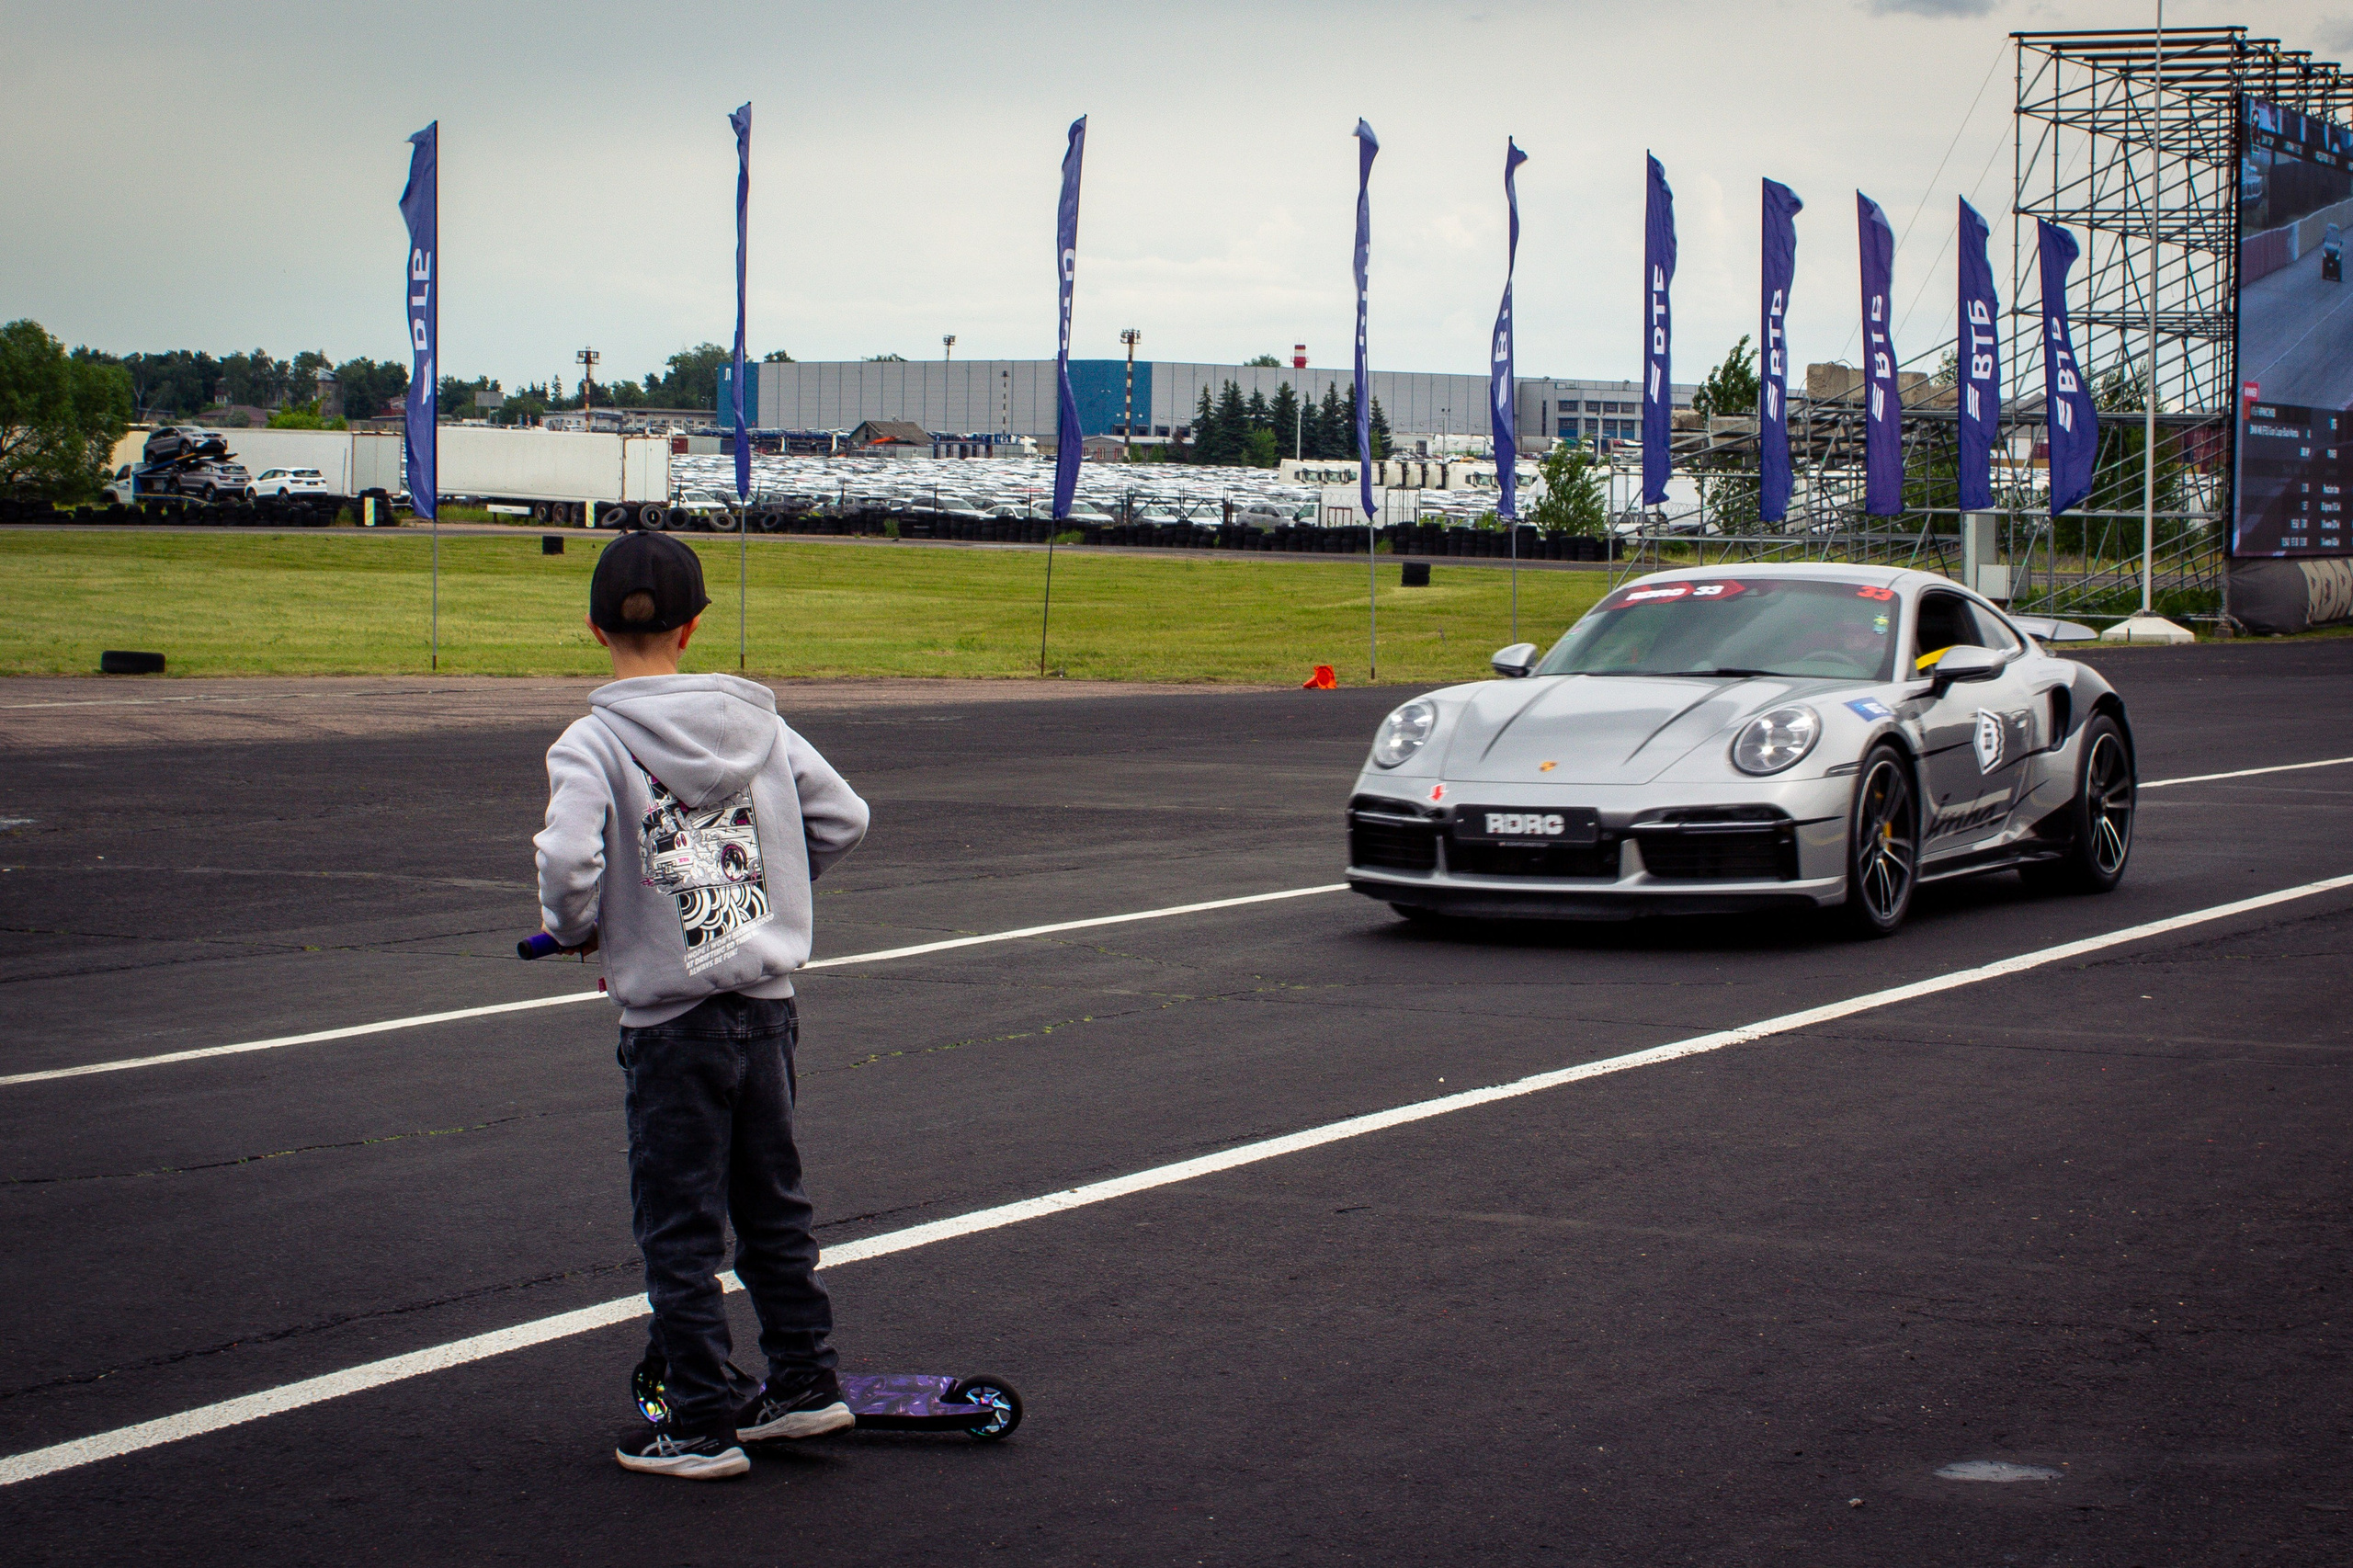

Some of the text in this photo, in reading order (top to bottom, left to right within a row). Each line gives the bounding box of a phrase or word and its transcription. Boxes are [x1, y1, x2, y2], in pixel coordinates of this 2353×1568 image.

[1967, 299, 1994, 380] ВТБ
[2052, 316, 2078, 393] ВТБ
[1692, 585, 1725, 596] 33
[1857, 585, 1894, 601] 33
[1484, 813, 1564, 835] RDRC
[686, 941, 735, 970] AT DRIFTING SO
[688, 946, 706, 961] HOPE
[689, 960, 714, 977] ALWAYS
[714, 955, 723, 966] BE
